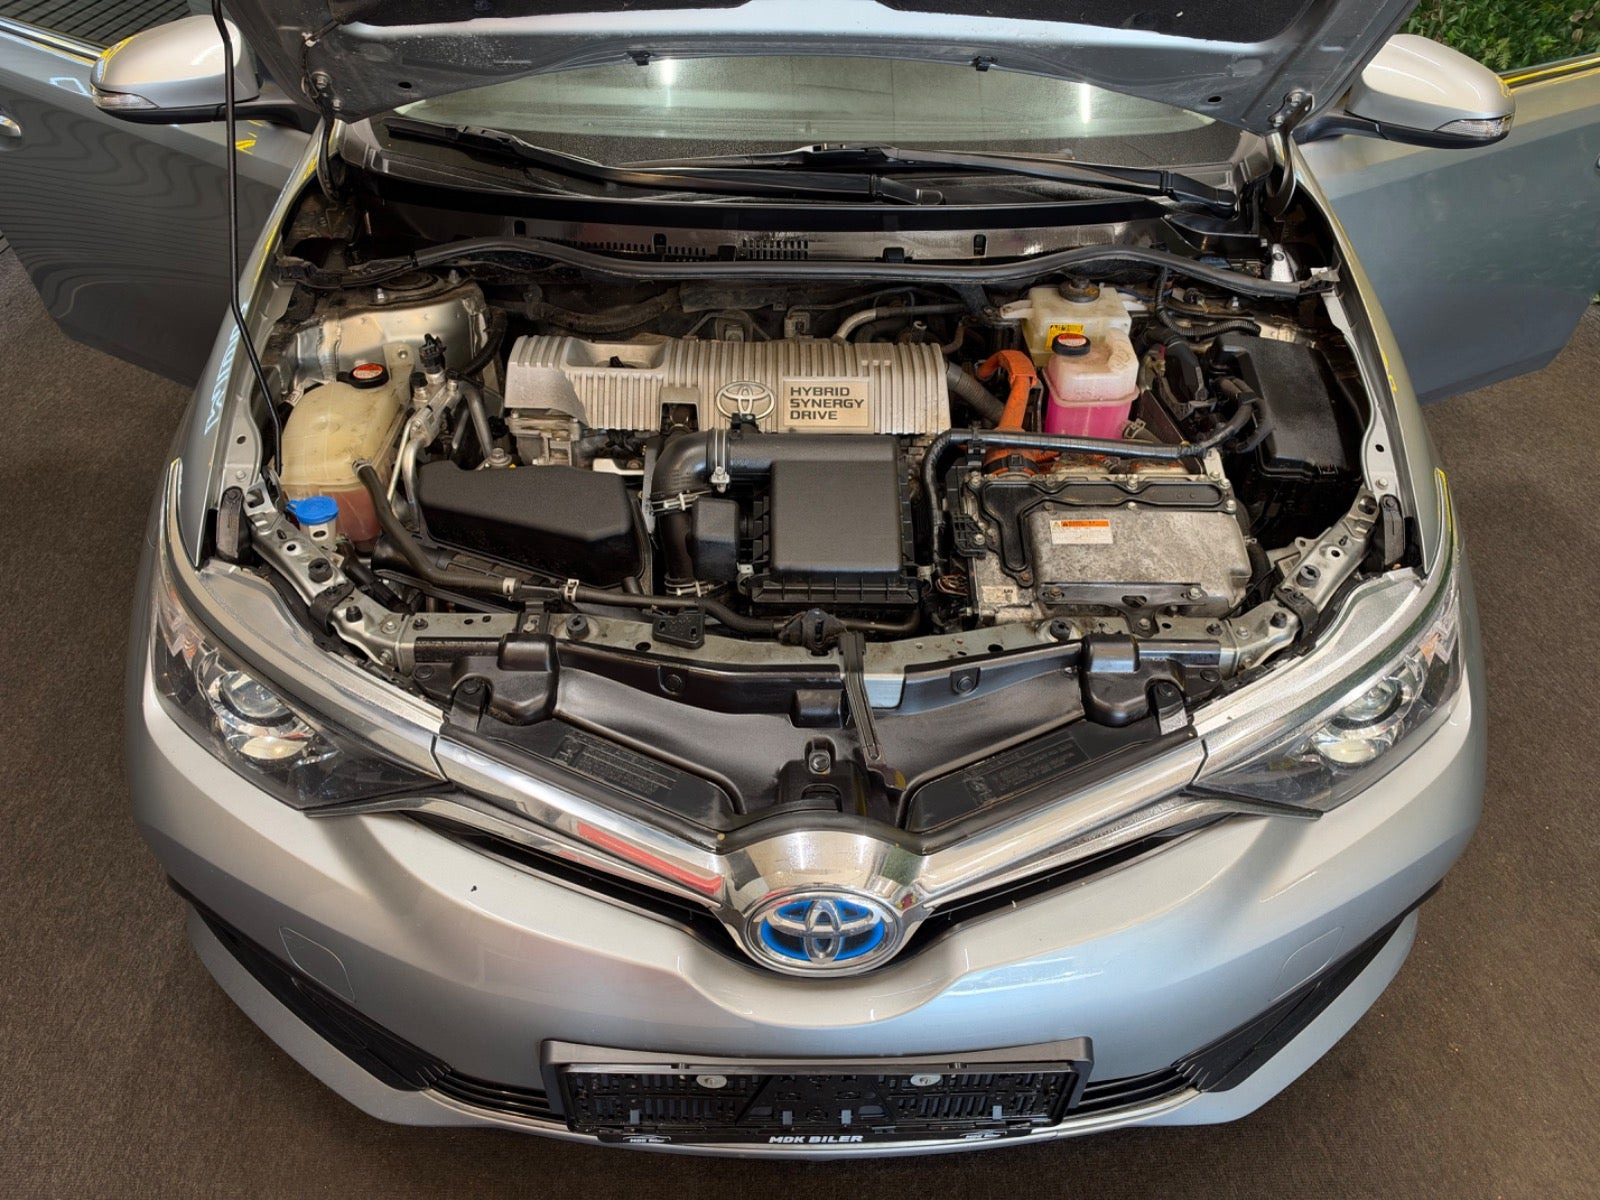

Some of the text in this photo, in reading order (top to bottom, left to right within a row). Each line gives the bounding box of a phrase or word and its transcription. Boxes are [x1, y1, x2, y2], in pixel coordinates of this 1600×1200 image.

[790, 386, 850, 396] HYBRID
[790, 398, 865, 409] SYNERGY
[790, 410, 838, 420] DRIVE
[768, 1135, 864, 1144] MDK BILER
